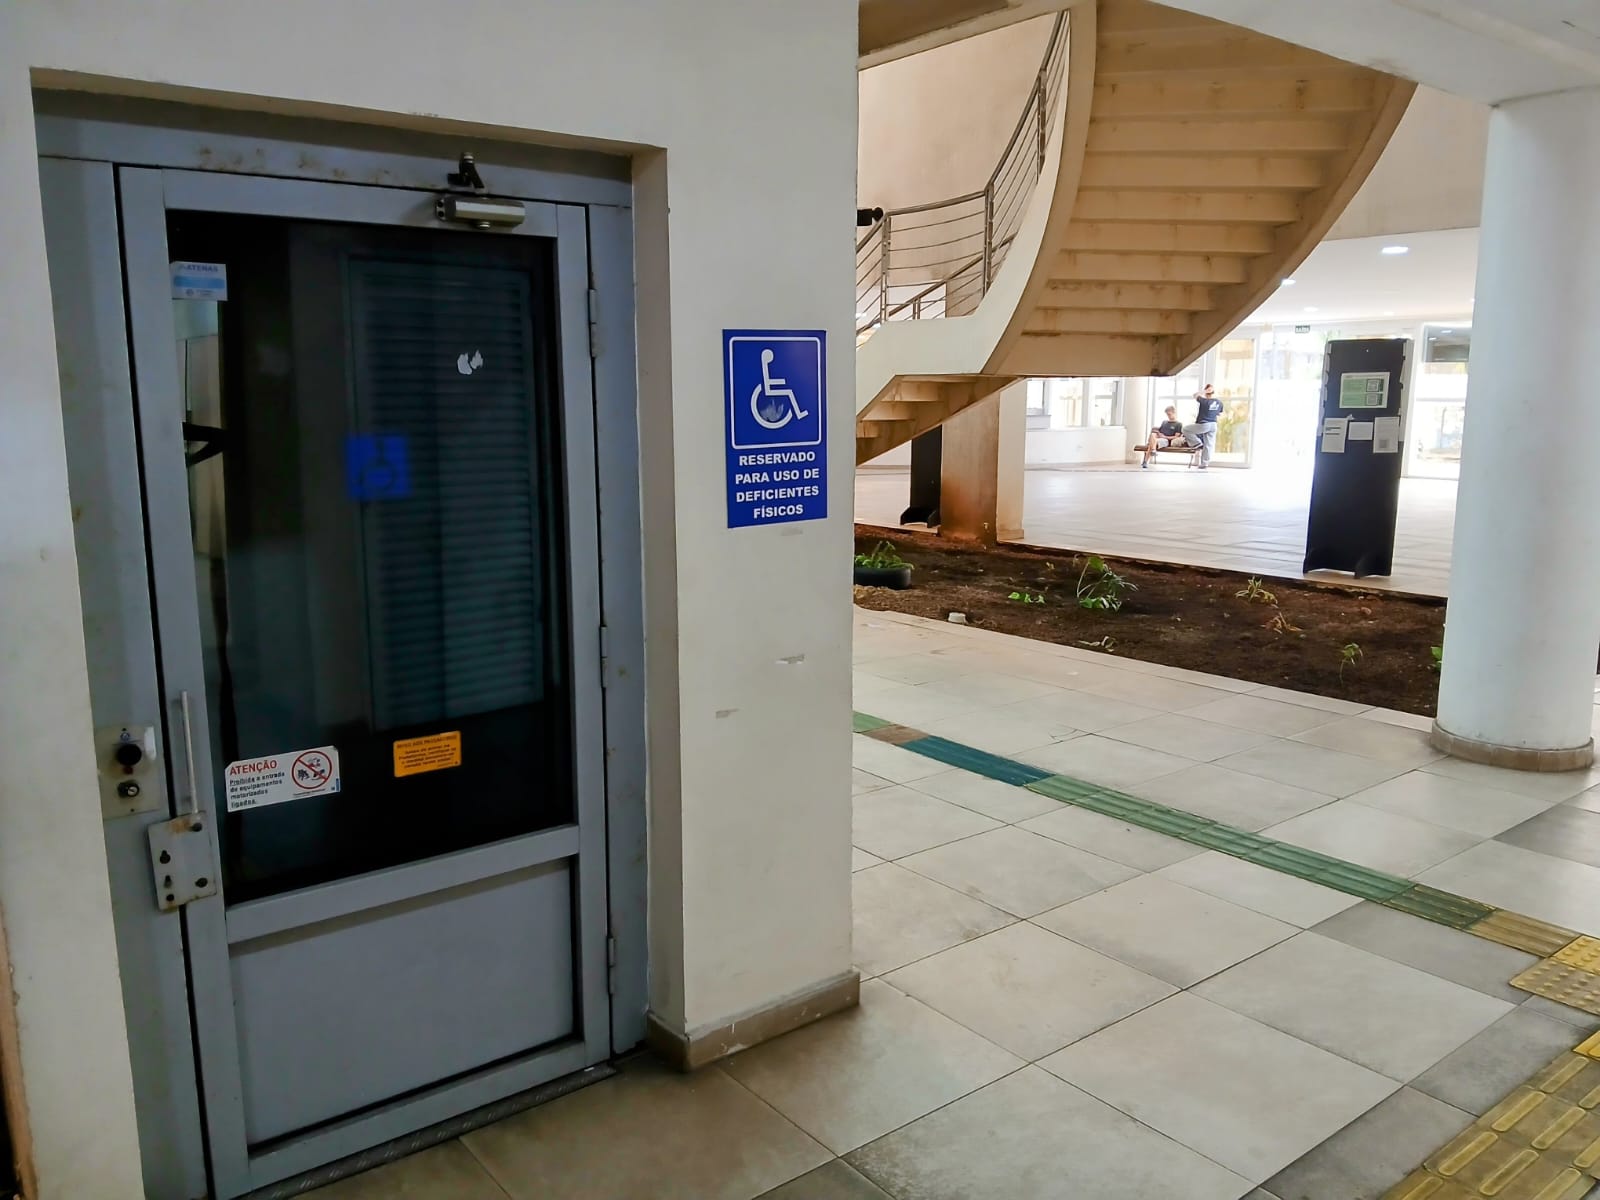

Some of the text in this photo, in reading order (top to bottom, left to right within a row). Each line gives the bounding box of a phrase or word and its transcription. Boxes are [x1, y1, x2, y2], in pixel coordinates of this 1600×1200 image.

[739, 451, 815, 466] RESERVADO
[735, 468, 819, 484] PARA USO DE
[736, 485, 819, 502] DEFICIENTES
[753, 504, 803, 518] FÍSICOS
[230, 760, 277, 775] ATENÇÃO
[262, 771, 285, 780] entrada
[239, 779, 282, 792] equipamentos
[230, 789, 268, 799] motorizados
